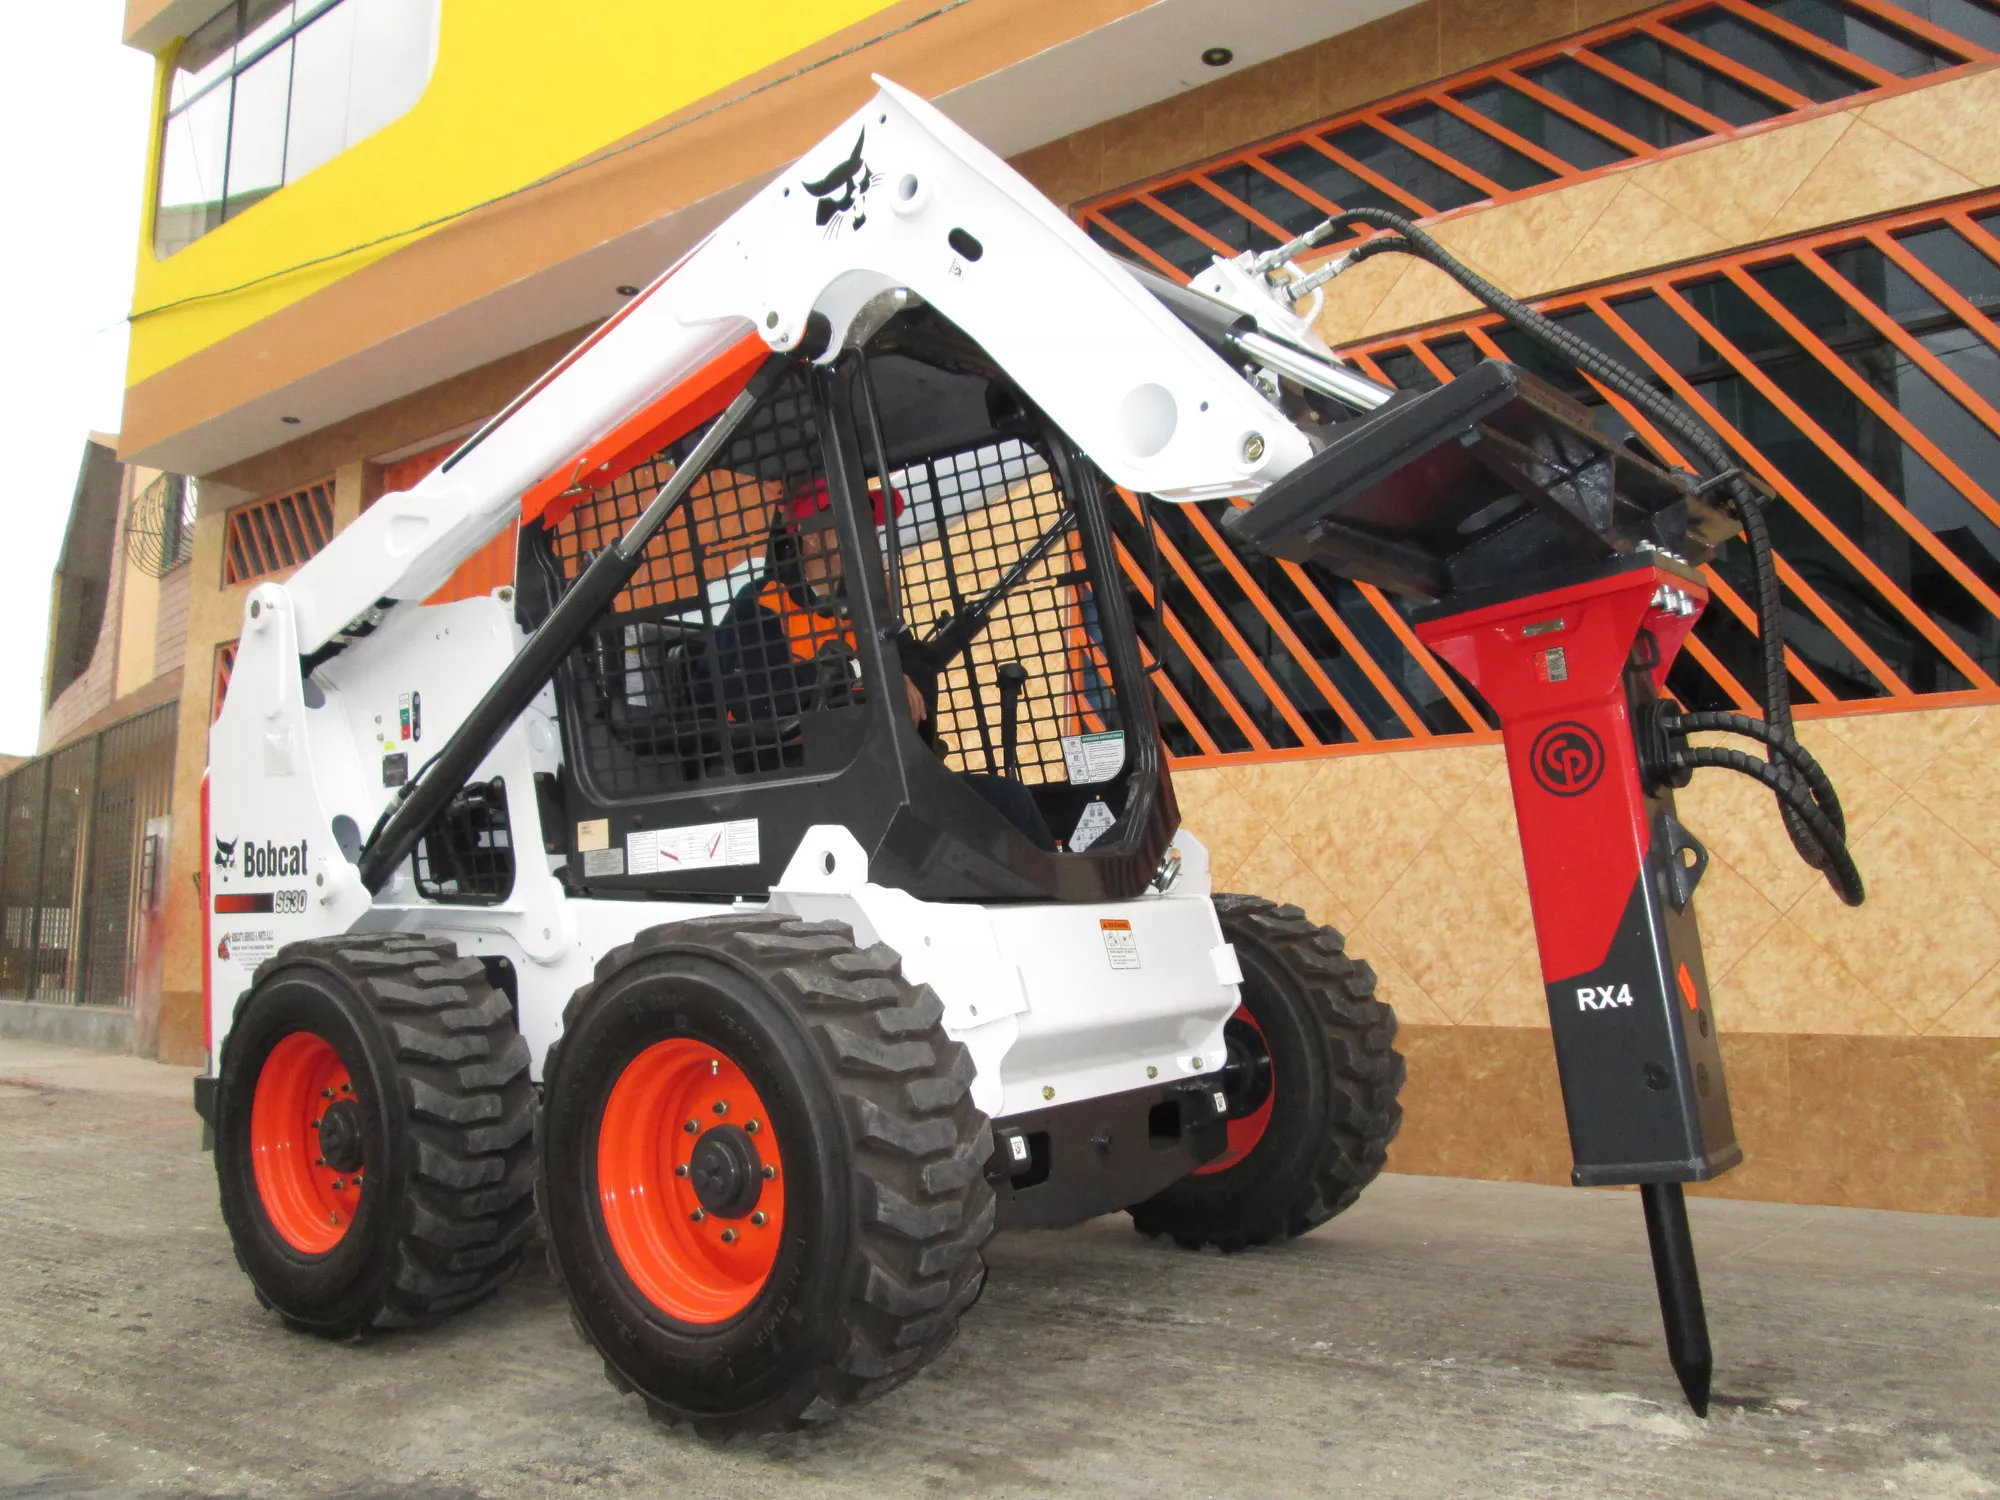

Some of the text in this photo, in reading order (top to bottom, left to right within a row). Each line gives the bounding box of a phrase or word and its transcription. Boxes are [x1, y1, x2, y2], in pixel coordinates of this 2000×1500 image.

[244, 838, 308, 878] Bobcat
[275, 889, 308, 914] S630
[1576, 983, 1634, 1011] RX4
